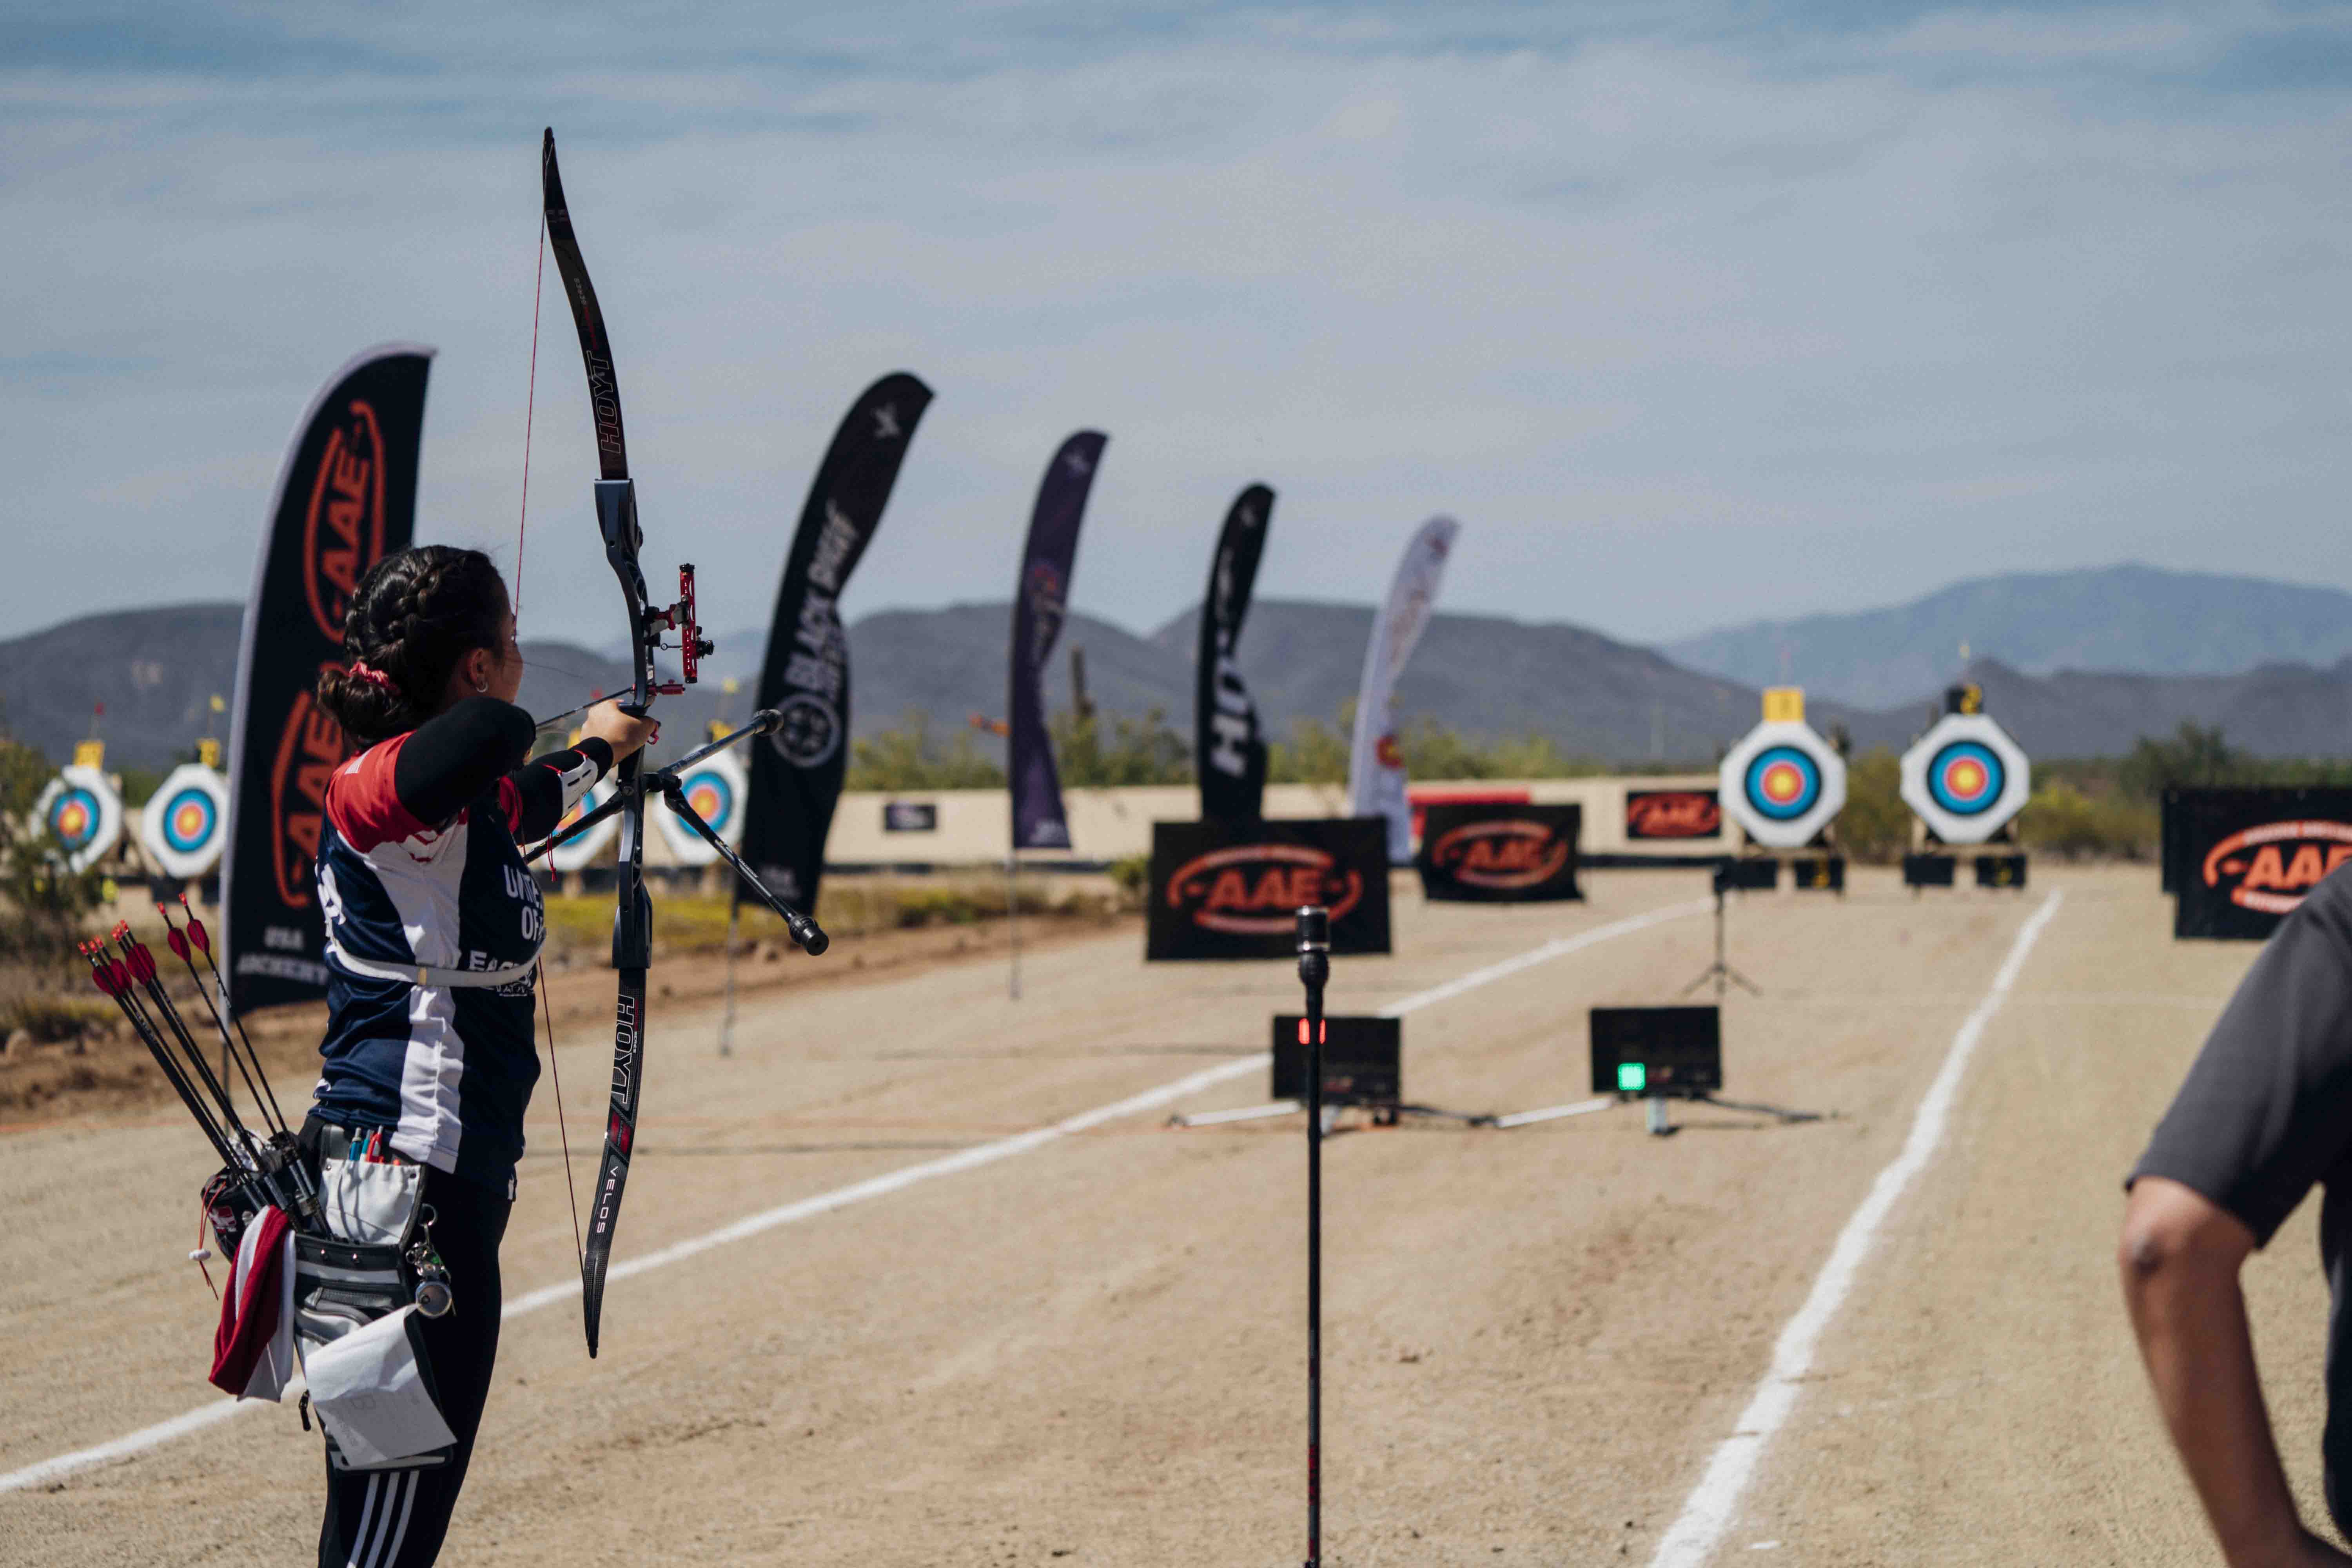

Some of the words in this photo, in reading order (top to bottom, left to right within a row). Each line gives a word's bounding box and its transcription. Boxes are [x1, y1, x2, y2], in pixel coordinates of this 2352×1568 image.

[586, 350, 621, 454] HOYT
[321, 447, 369, 597] AAE
[503, 864, 543, 910] UNITE
[1203, 866, 1323, 911] AAE
[610, 994, 635, 1104] HOYT
[596, 1166, 619, 1234] VELOS
